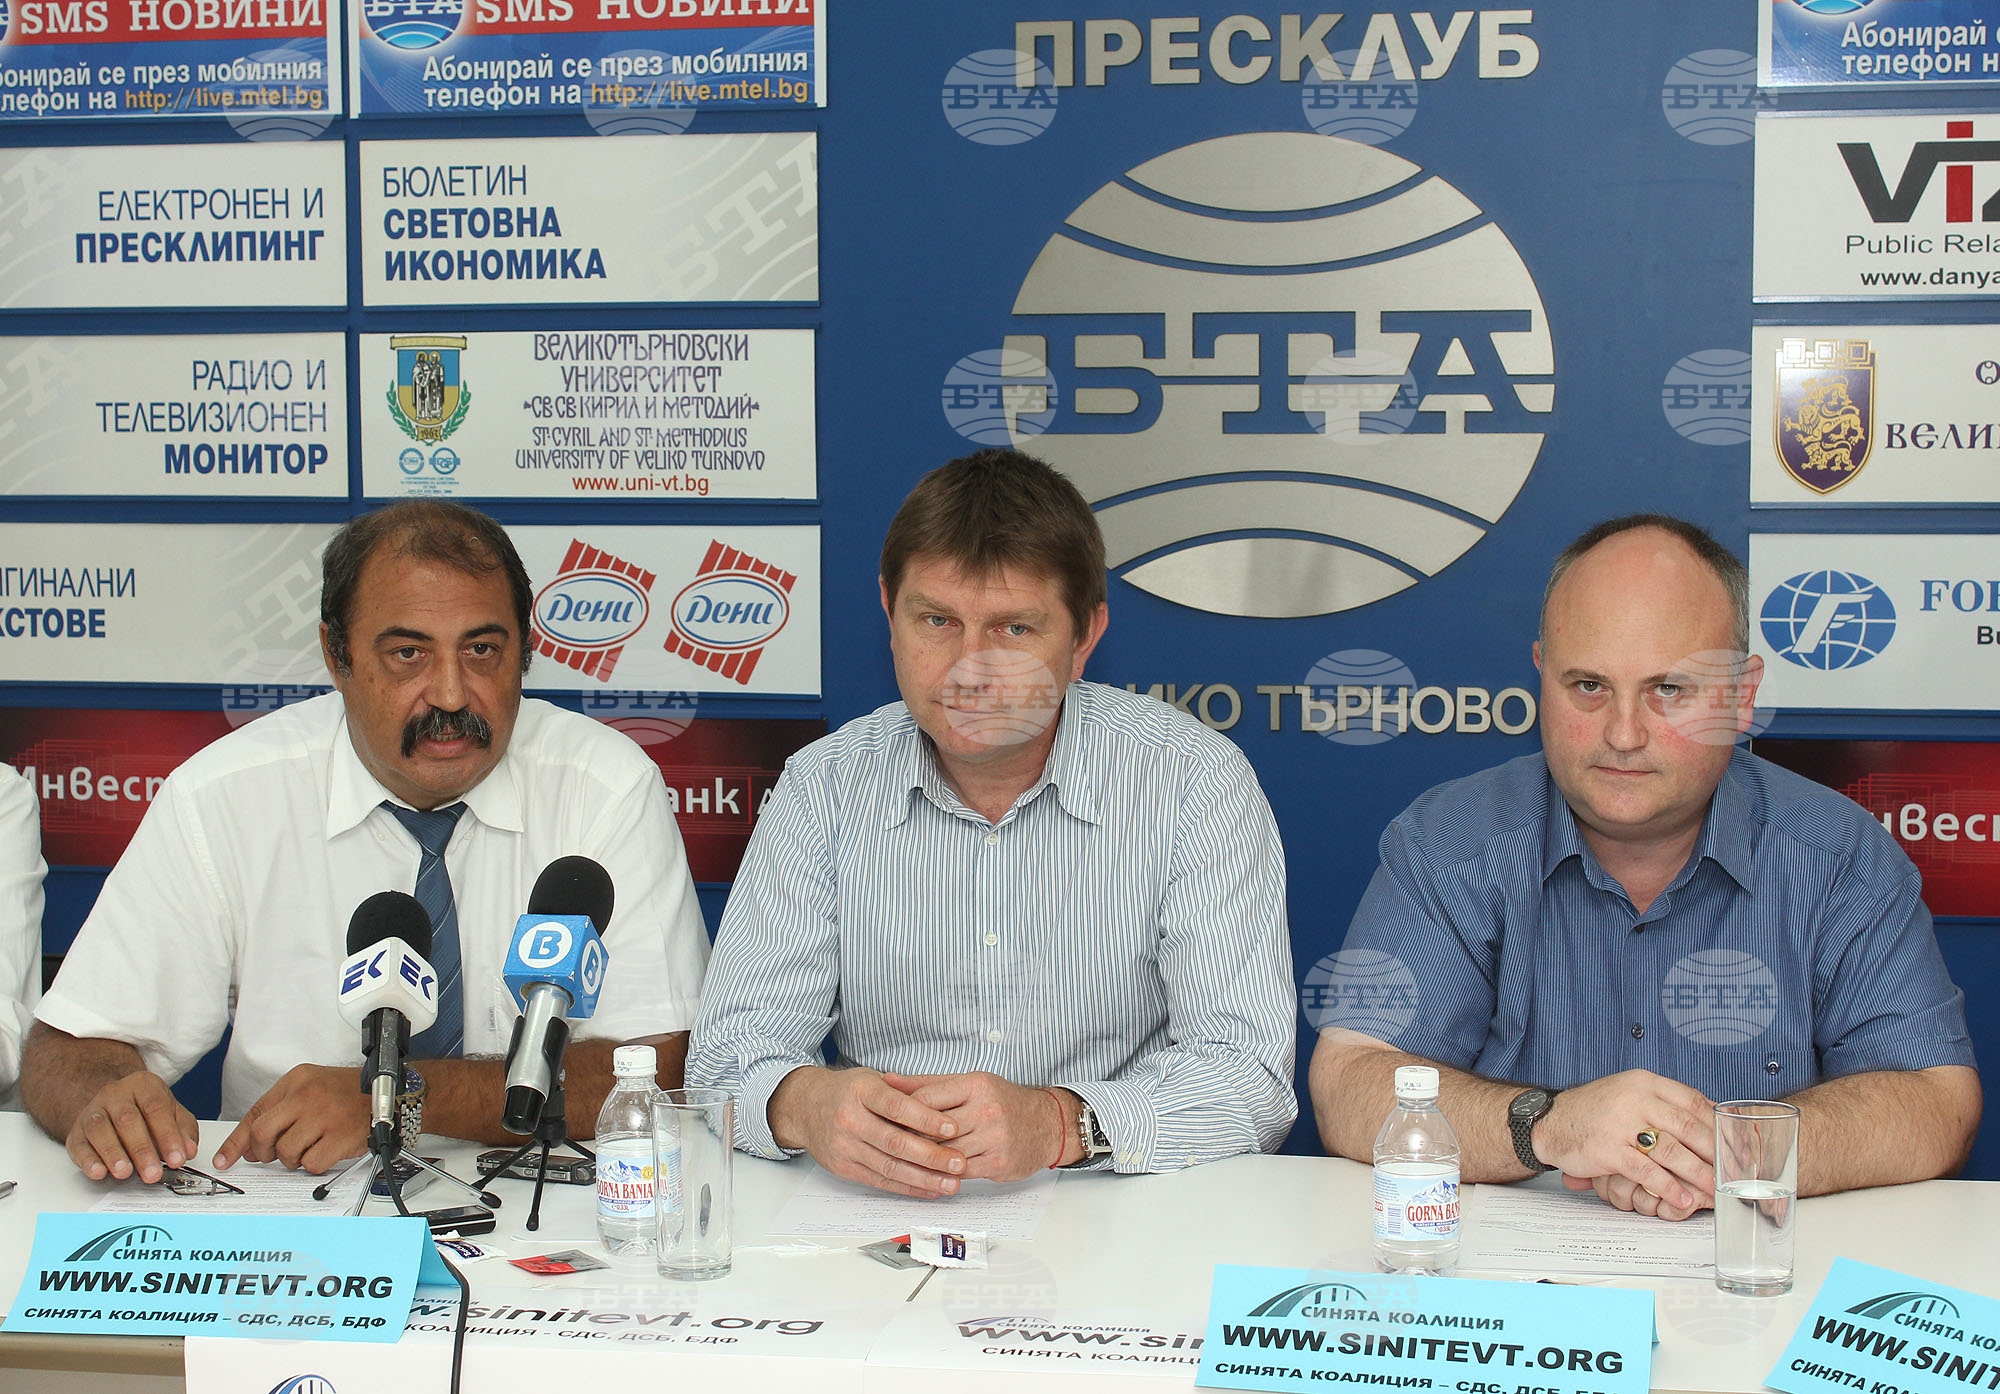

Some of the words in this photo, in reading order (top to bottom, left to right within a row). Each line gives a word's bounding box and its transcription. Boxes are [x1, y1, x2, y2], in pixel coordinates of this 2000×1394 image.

[21, 1, 109, 34] SMS
[129, 0, 322, 31] НОВИНИ
[1015, 9, 1540, 87] ПРЕСКЛУБ
[1841, 19, 1986, 53] Абонирай
[0, 61, 91, 92] онирай
[98, 66, 126, 85] се
[133, 63, 190, 87] през
[198, 57, 321, 82] мобилния
[423, 51, 553, 84] Абонирай
[562, 56, 592, 78] се
[600, 54, 663, 82] през
[672, 47, 808, 75] мобилния
[1841, 48, 1970, 80] телефон
[88, 90, 117, 110] на
[125, 85, 322, 112] http://live.mtel.bg
[424, 80, 540, 110] телефон
[550, 85, 581, 105] на
[591, 78, 808, 106] http://live.mtel.bg
[383, 164, 527, 198] БЮЛЕТИН
[98, 188, 290, 222] ЕЛЕКТРОНЕН
[303, 187, 324, 219] И
[383, 206, 562, 239] СВЕТОВНА
[75, 230, 325, 264] ПРЕСКЛИПИНГ
[1846, 234, 1933, 255] Public
[385, 247, 607, 281] ИКОНОМИКА
[192, 360, 293, 396] РАДИО
[306, 359, 326, 391] И
[561, 365, 722, 393] УНИВЕРСИТЕТ
[1010, 309, 1545, 436] БТА
[95, 401, 327, 433] ТЕЛЕВИЗИОНЕН
[599, 427, 631, 447] AND
[1884, 422, 2000, 450] ВЕЛИ
[164, 443, 328, 475] МОНИТОР
[609, 449, 630, 470] OF
[572, 473, 709, 496] www.uni-vt.bg
[0, 567, 135, 598] ГИНАЛНИ
[0, 607, 106, 638] СТОВЕ
[1256, 684, 1537, 736] ТЪРНОВО
[622, 1182, 654, 1200] BANIA
[1407, 1204, 1444, 1222] GORNA
[112, 1247, 183, 1263] СИНЯТА
[189, 1248, 293, 1266] КОАЛИЦИЯ
[39, 1269, 393, 1299] WWW.SINITEVT.ORG
[24, 1307, 103, 1321] СИНЯТА
[108, 1309, 218, 1326] КОАЛИЦИЯ
[237, 1312, 283, 1328] СДС,
[288, 1313, 336, 1329] ДСБ,
[342, 1315, 388, 1330] БДФ
[1300, 1305, 1381, 1323] СИНЯТА
[1387, 1311, 1505, 1331] КОАЛИЦИЯ
[1894, 1312, 1964, 1342] СИНЯТА
[982, 1346, 1082, 1360] СИНЯТА
[1091, 1352, 1201, 1365] КОАЛИЦ
[1222, 1324, 1624, 1374] WWW.SINITEVT.ORG
[1214, 1362, 1304, 1379] СИНЯТА
[1310, 1369, 1433, 1389] КОАЛИЦИЯ
[1790, 1358, 1866, 1391] СИНЯТА
